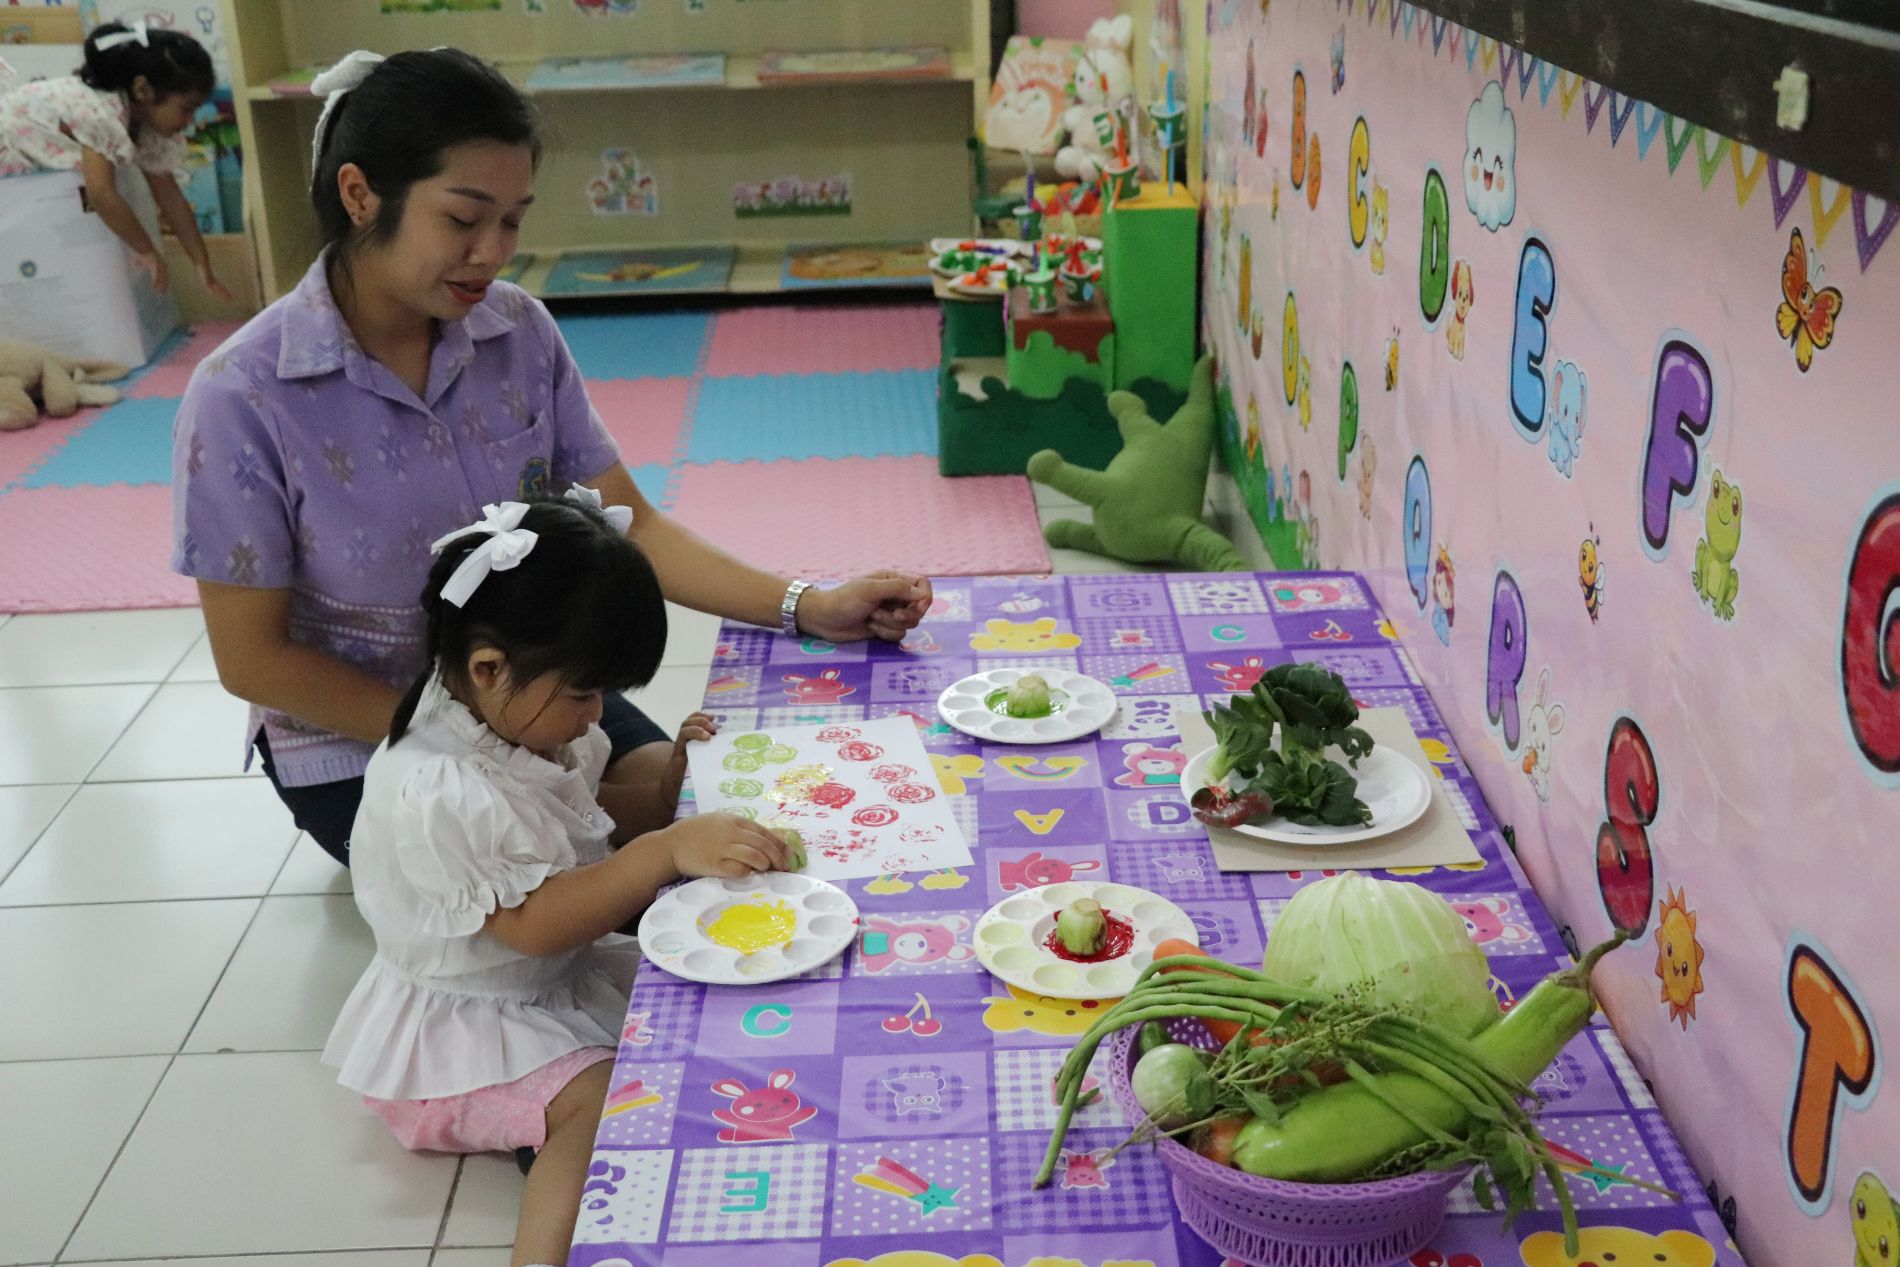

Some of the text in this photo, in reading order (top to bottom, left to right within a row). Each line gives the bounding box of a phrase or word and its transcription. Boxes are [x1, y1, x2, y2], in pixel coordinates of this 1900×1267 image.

[1349, 116, 1369, 249] C
[1420, 168, 1449, 323] D
[1283, 292, 1299, 406] O
[1510, 236, 1555, 433] E
[1338, 361, 1358, 481] P
[1643, 340, 1713, 549] F
[1210, 624, 1247, 642] C
[1486, 569, 1527, 751] R
[1014, 808, 1064, 835] A
[1147, 801, 1191, 825] D
[1597, 716, 1659, 939] S
[741, 1003, 792, 1036] C
[1788, 943, 1874, 1202] T
